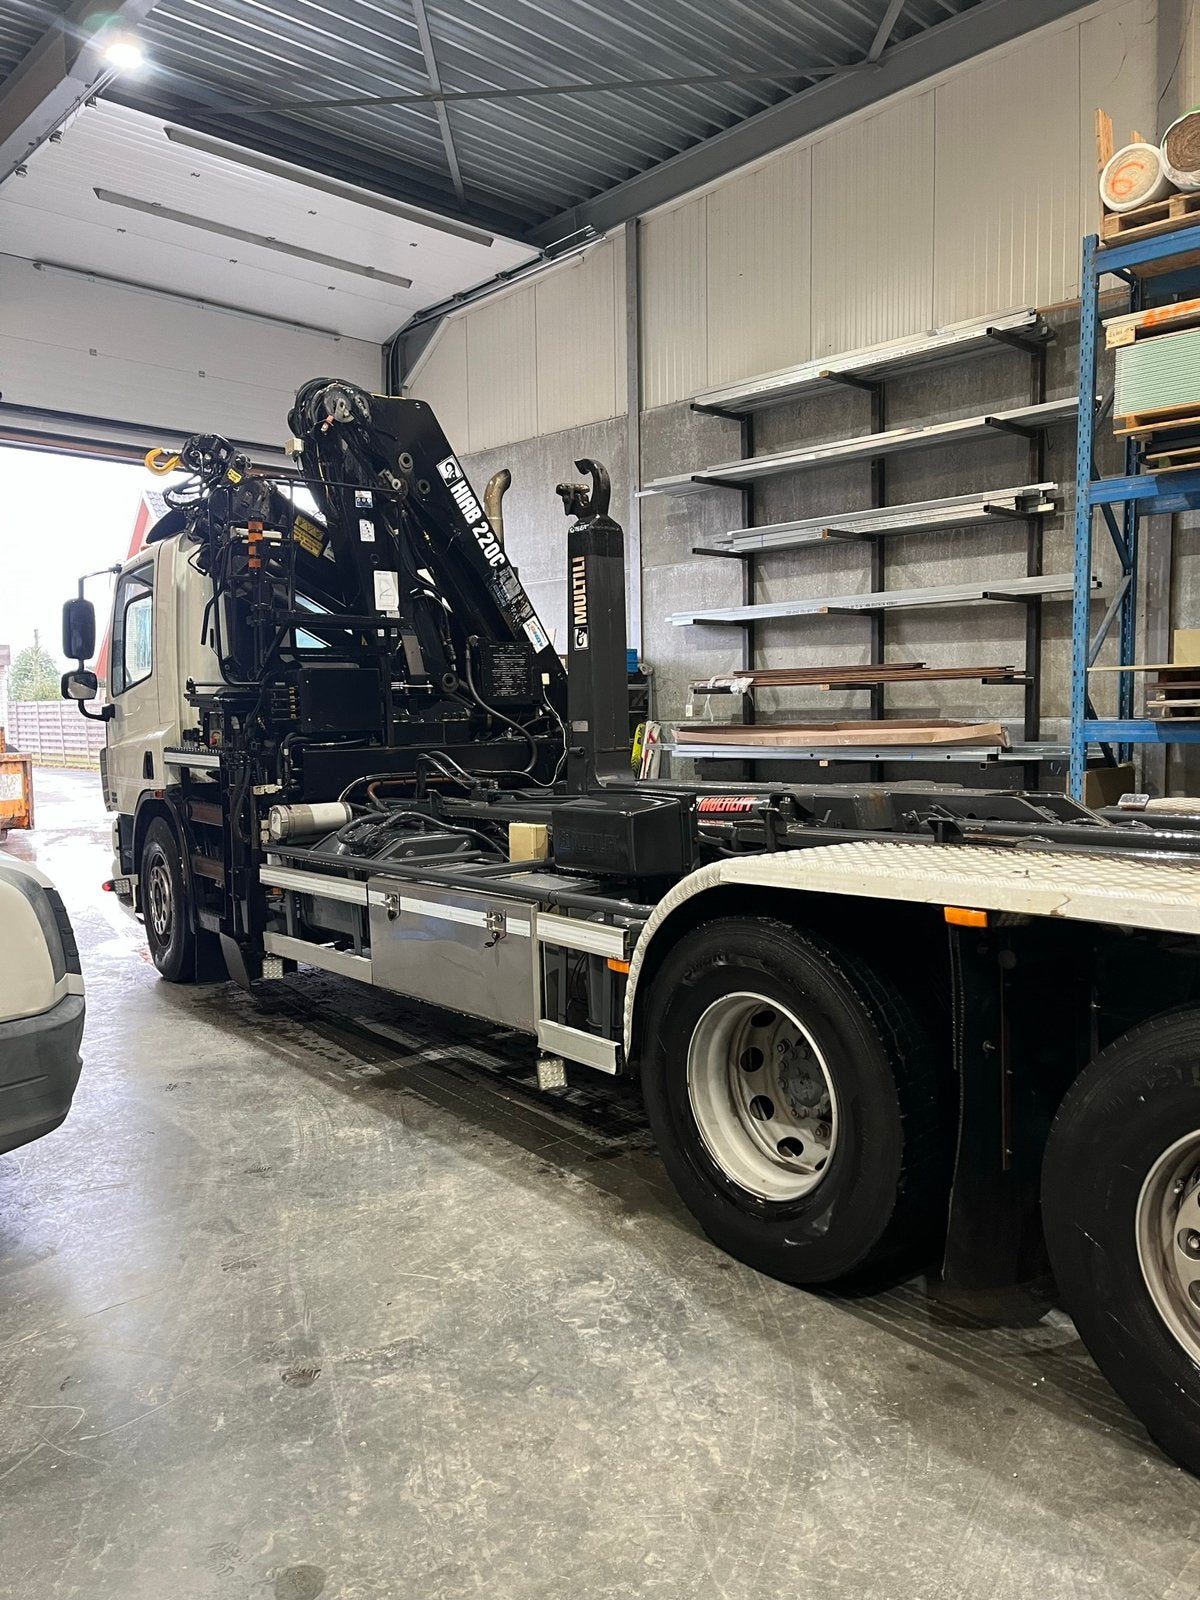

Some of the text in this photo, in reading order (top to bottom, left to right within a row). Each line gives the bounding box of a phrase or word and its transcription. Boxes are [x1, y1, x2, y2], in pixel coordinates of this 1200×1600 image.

[450, 480, 506, 568] HIAB 220C
[698, 796, 758, 812] MULTILIFT
